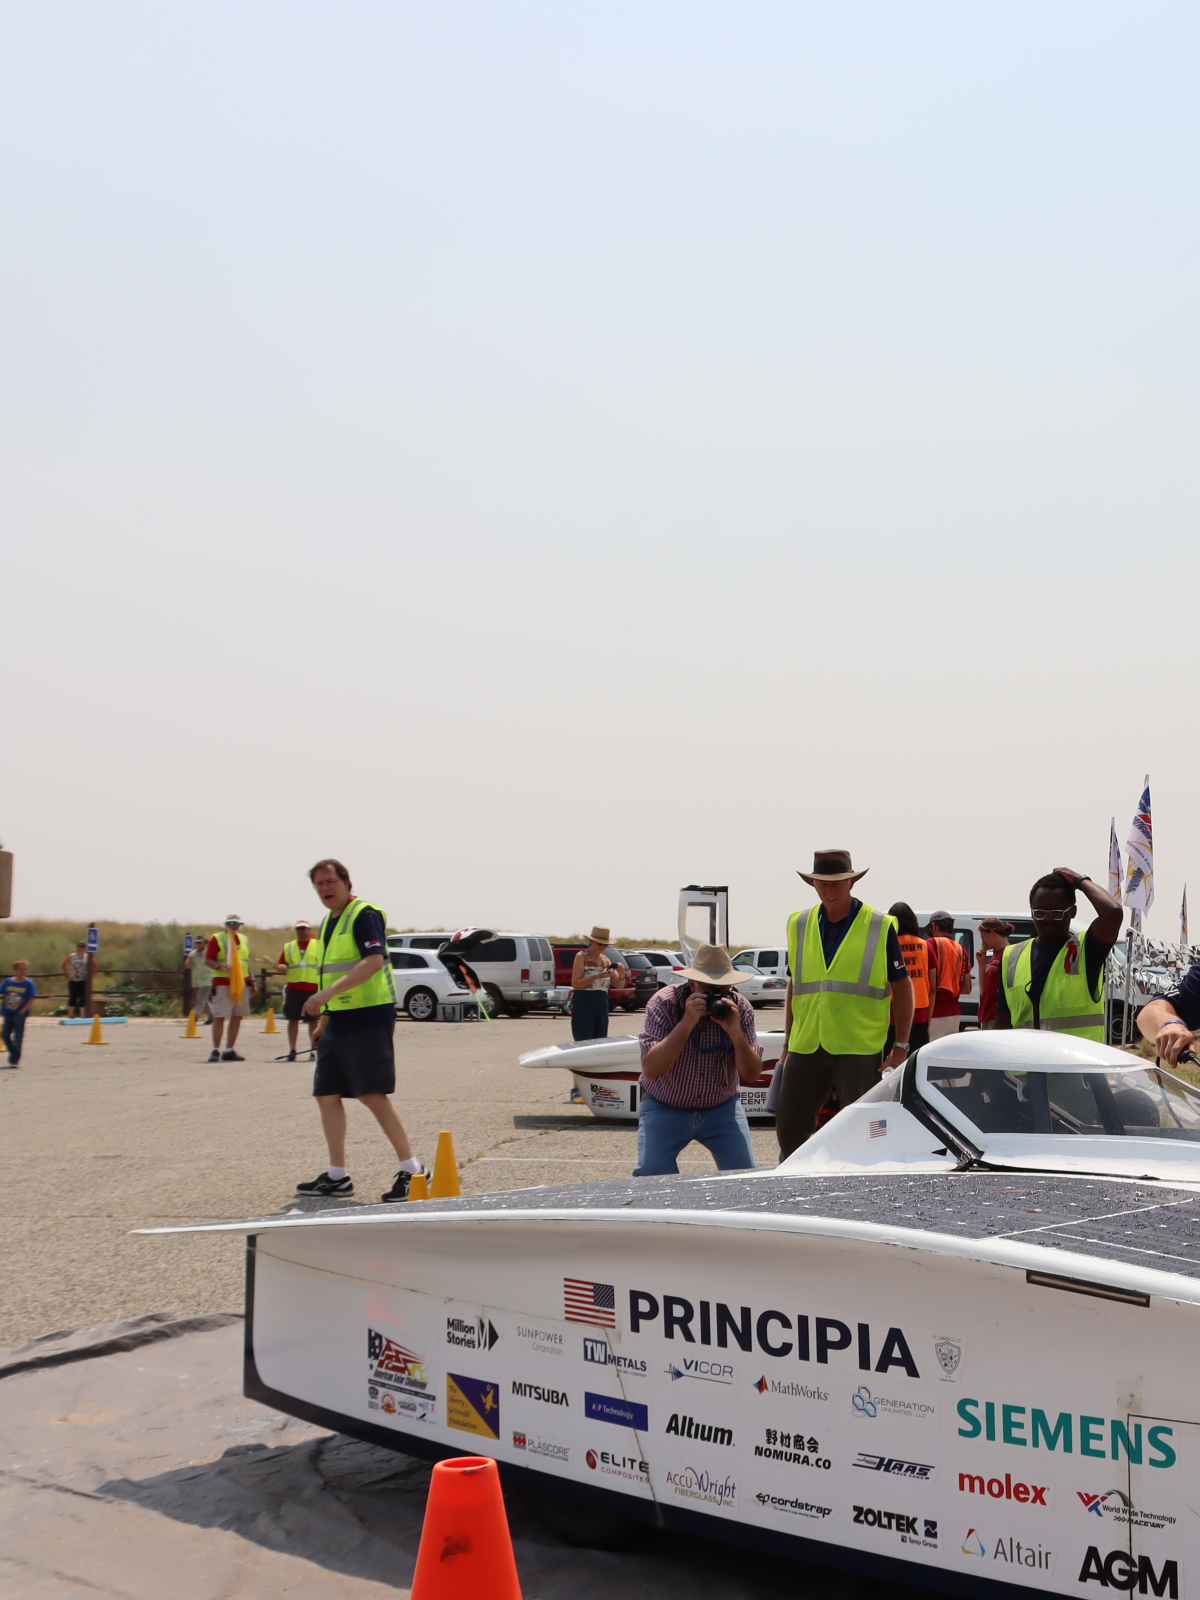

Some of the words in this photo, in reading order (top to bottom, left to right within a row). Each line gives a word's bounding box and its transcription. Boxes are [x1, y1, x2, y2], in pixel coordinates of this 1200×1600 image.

[447, 1317, 475, 1335] Million
[517, 1326, 563, 1345] SUNPOWER
[629, 1289, 920, 1379] PRINCIPIA
[446, 1331, 476, 1349] Stories
[532, 1342, 563, 1356] Corporation
[585, 1340, 606, 1363] TW
[607, 1354, 647, 1372] METALS
[683, 1358, 733, 1378] VICOR
[512, 1381, 569, 1408] MITSUBA
[771, 1380, 829, 1401] MathWorks
[603, 1405, 634, 1420] Technology
[873, 1397, 935, 1413] GENERATION
[956, 1397, 1177, 1469] SIEMENS
[528, 1439, 570, 1457] PLASCORE
[754, 1445, 831, 1470] NOMURA.CO
[601, 1452, 649, 1474] ELITE
[601, 1467, 650, 1484] COMPOSITES
[958, 1472, 1047, 1506] molex
[770, 1498, 832, 1518] cordstrap
[1102, 1504, 1121, 1514] World
[1139, 1511, 1177, 1524] Technology
[853, 1505, 919, 1536] ZOLTEK
[1127, 1518, 1166, 1530] RACEWAY
[908, 1537, 921, 1546] Toray
[922, 1540, 938, 1549] Group
[993, 1537, 1052, 1571] Altair
[1078, 1545, 1179, 1600] AGM
